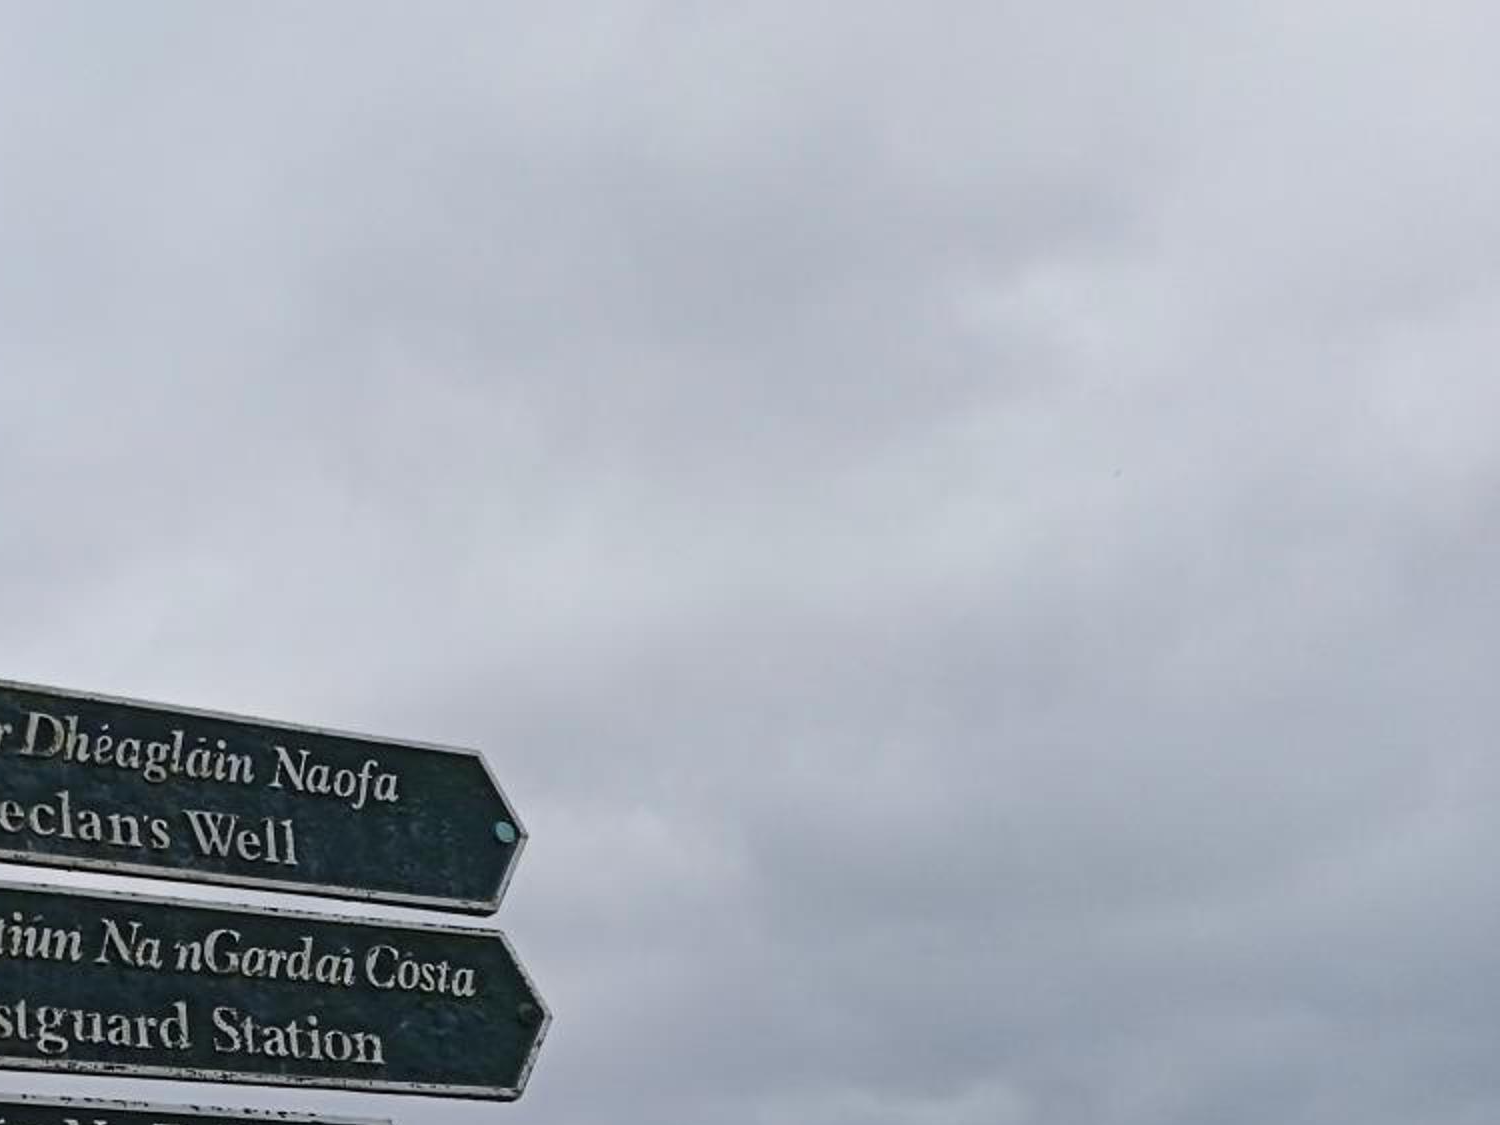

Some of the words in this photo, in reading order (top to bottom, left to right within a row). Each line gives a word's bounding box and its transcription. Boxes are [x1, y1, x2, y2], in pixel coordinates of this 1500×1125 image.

[20, 711, 255, 783] Dhéagláin
[267, 745, 400, 810] Naofa
[182, 808, 299, 866] Well
[92, 917, 163, 970] Na
[365, 944, 477, 997] Cósta
[212, 1005, 388, 1066] Station
